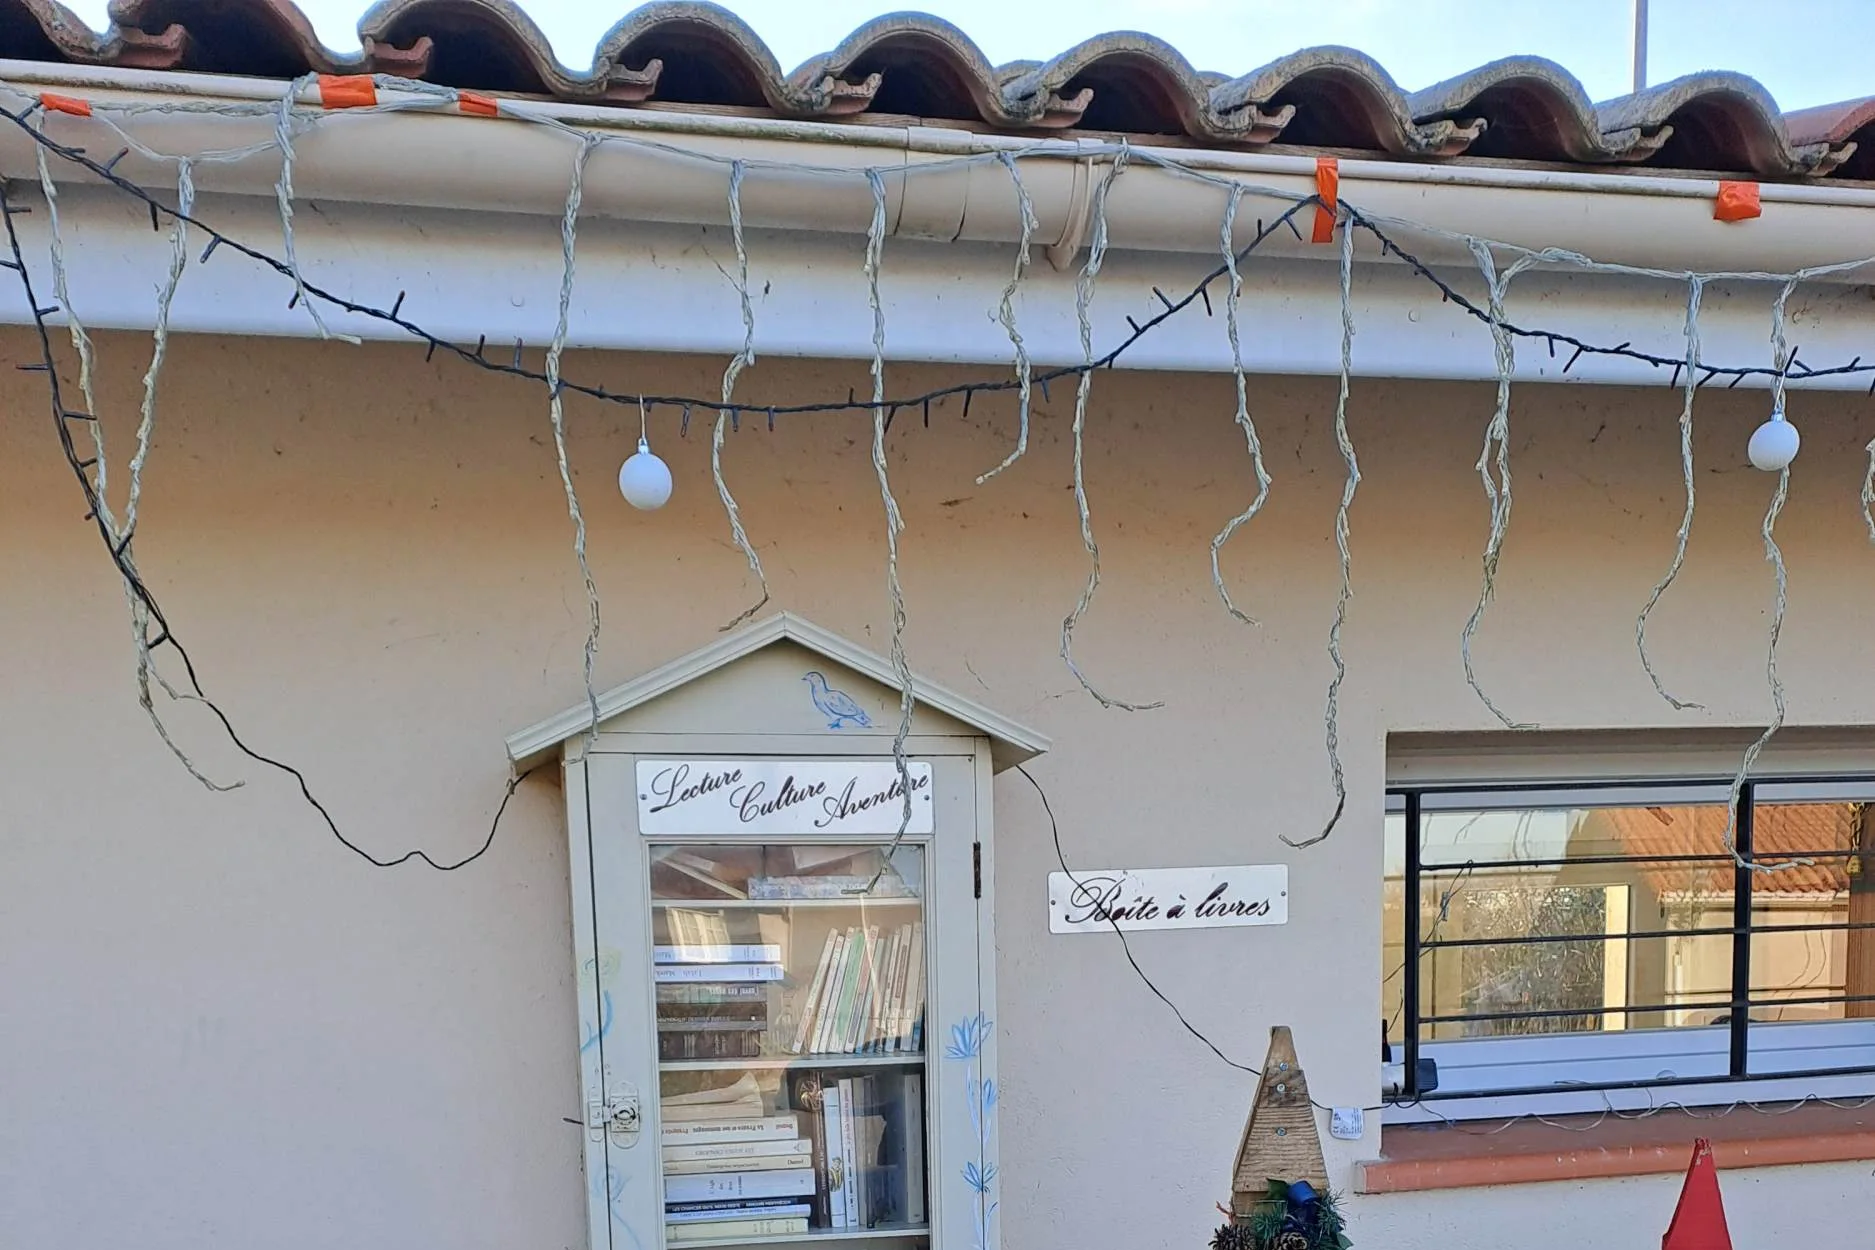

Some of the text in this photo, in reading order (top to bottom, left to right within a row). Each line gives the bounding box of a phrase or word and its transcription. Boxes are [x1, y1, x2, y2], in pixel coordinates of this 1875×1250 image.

[649, 763, 743, 813] Lecture
[729, 774, 827, 822] Culture
[1064, 876, 1271, 923] Boîte à livres
